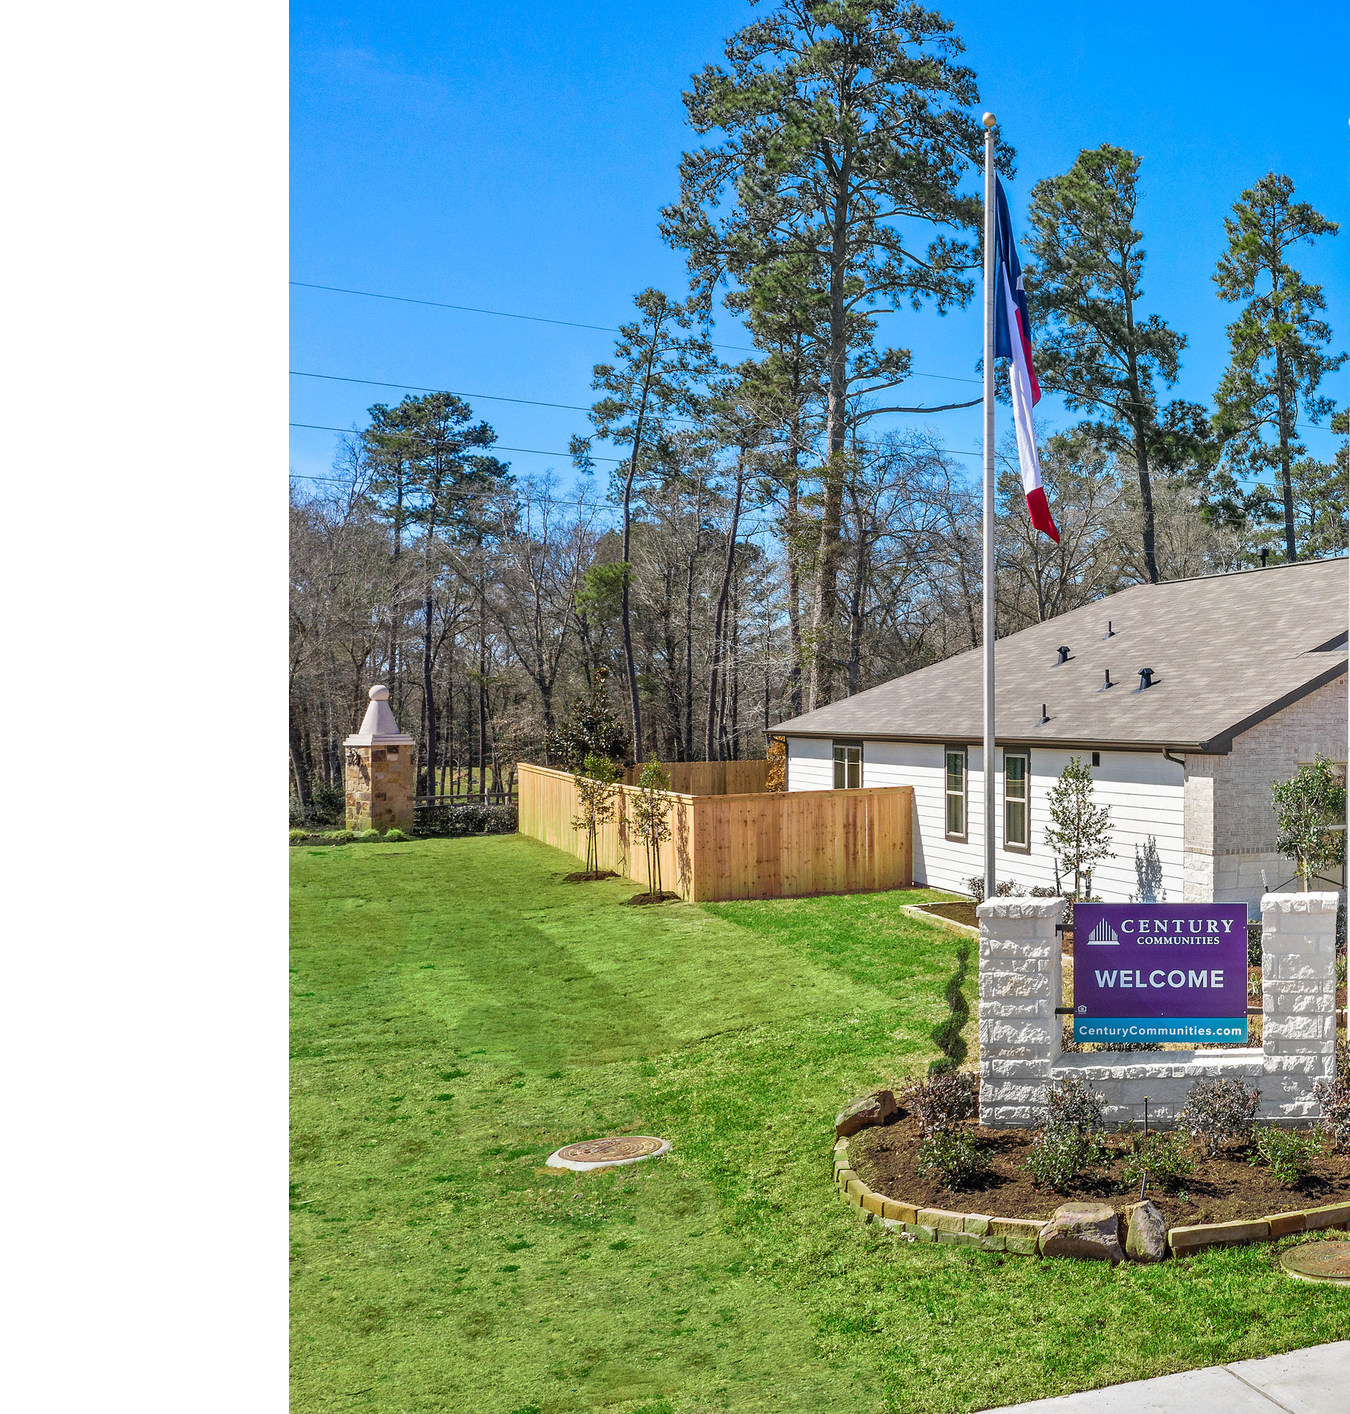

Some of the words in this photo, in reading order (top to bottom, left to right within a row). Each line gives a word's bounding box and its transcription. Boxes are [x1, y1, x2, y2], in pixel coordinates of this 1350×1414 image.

[1120, 919, 1234, 933] CENTURY
[1136, 936, 1220, 945] COMMUNITIES
[1094, 969, 1224, 988] WELCOME
[1079, 1025, 1242, 1038] CenturyCommunities.com
